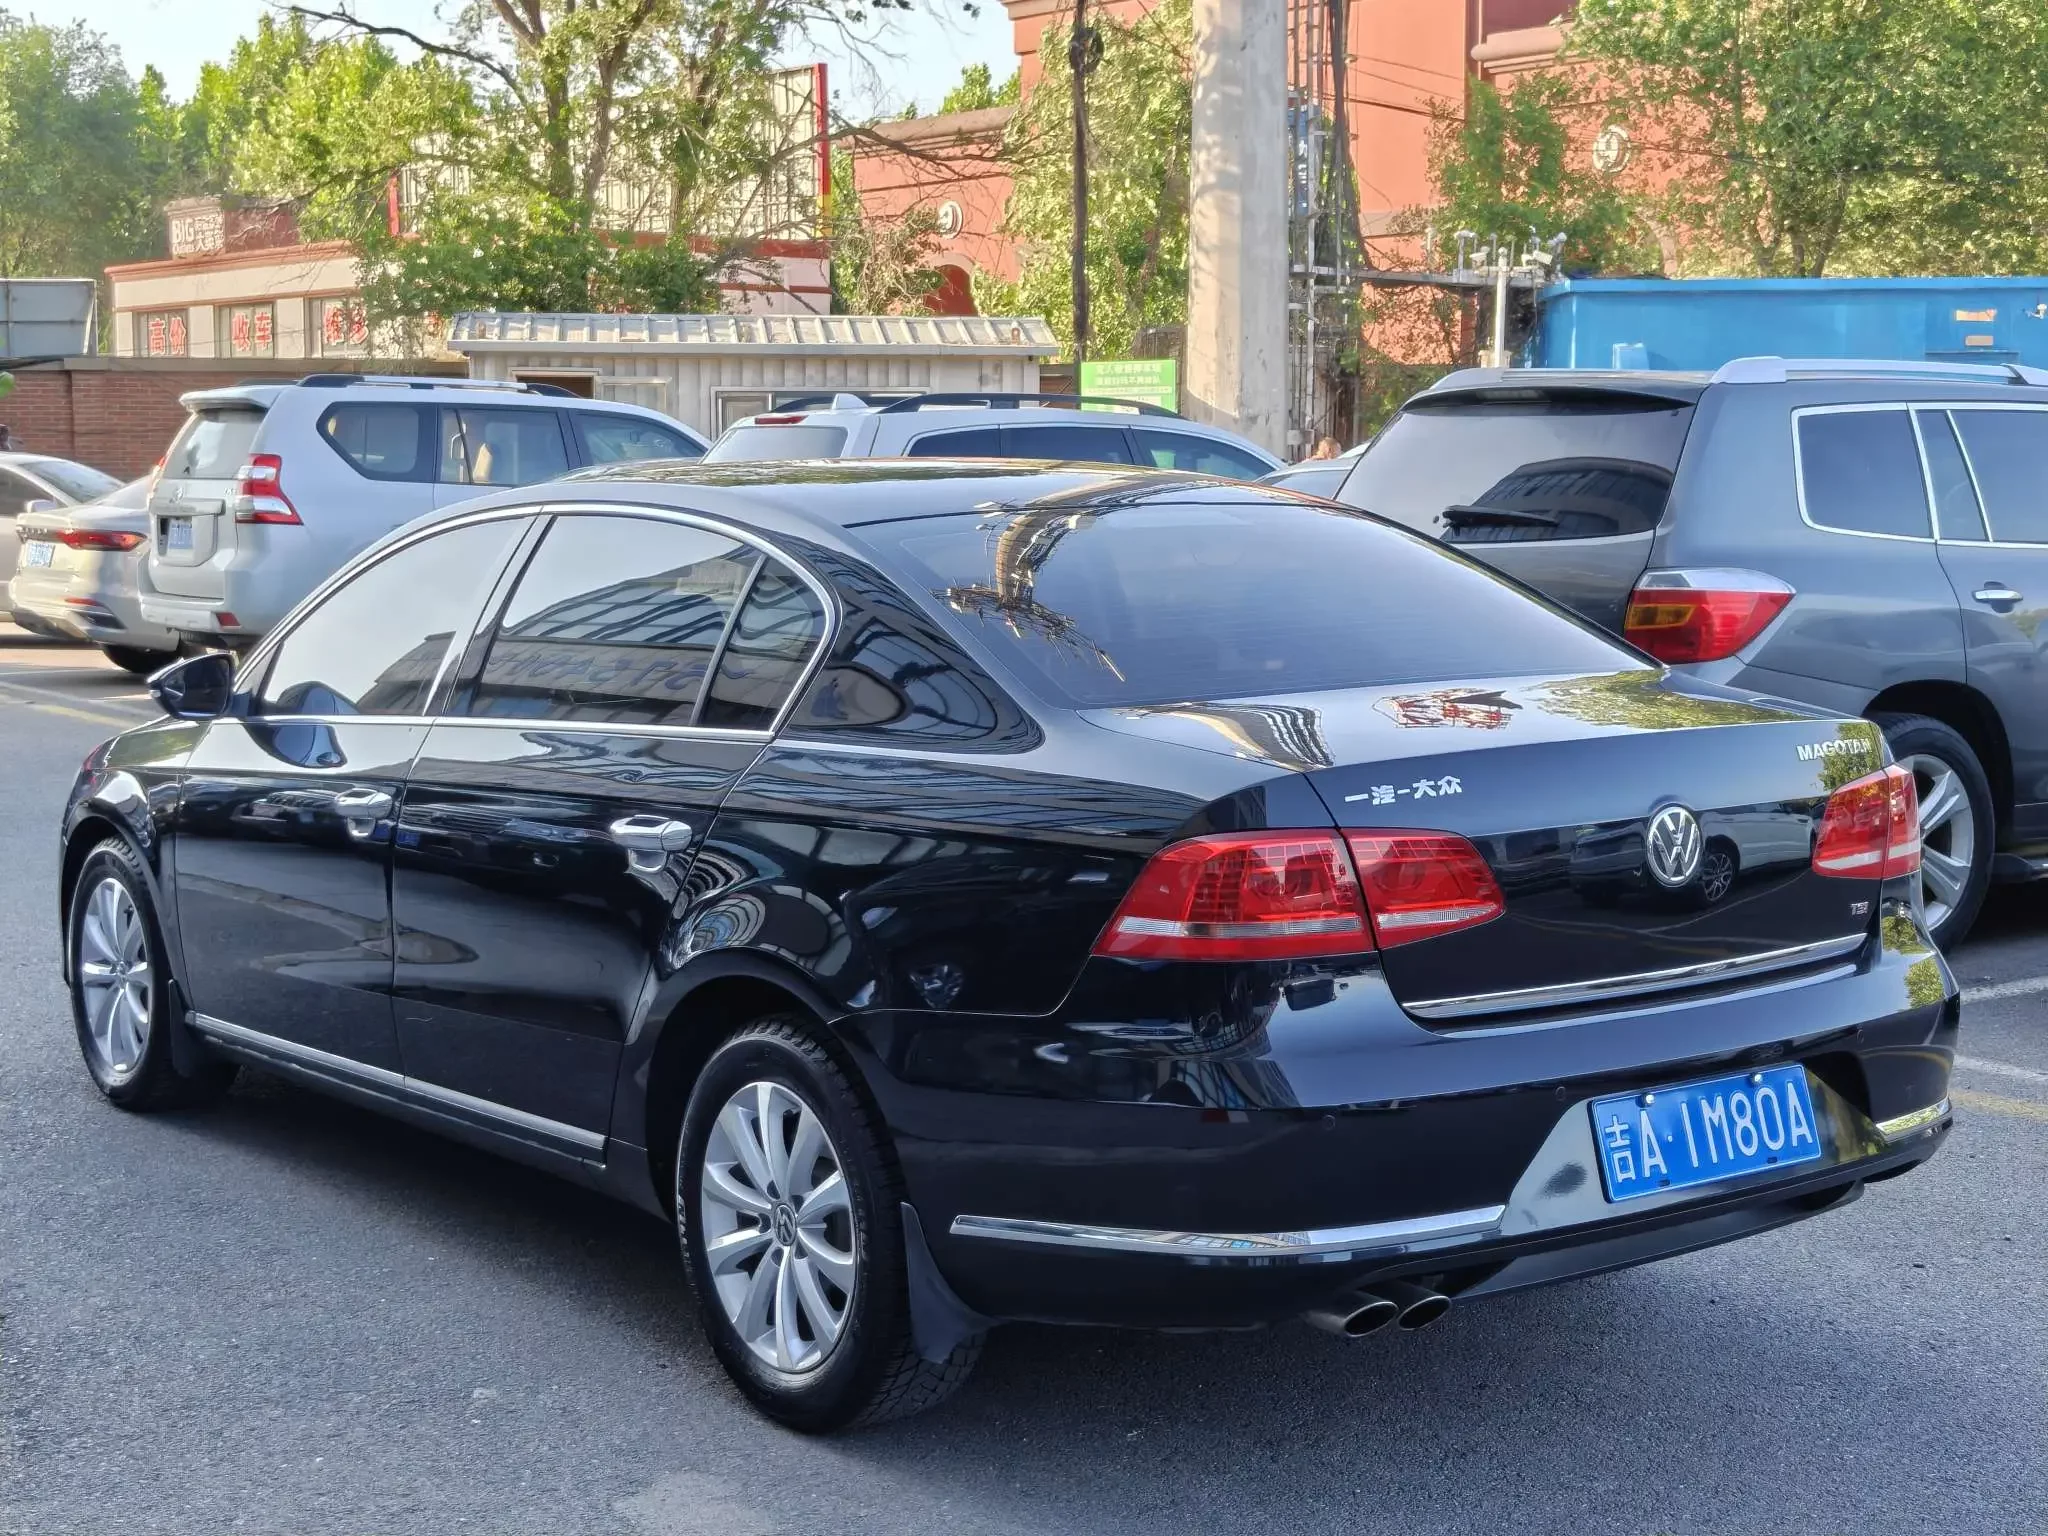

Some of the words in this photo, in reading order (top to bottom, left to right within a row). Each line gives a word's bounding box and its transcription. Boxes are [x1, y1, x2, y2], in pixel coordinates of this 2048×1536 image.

[172, 218, 195, 243] BIG
[148, 317, 186, 356] 高价
[231, 311, 272, 352] 收车
[1796, 738, 1872, 761] MAGOTAN
[1344, 775, 1463, 805] 一汽-大众
